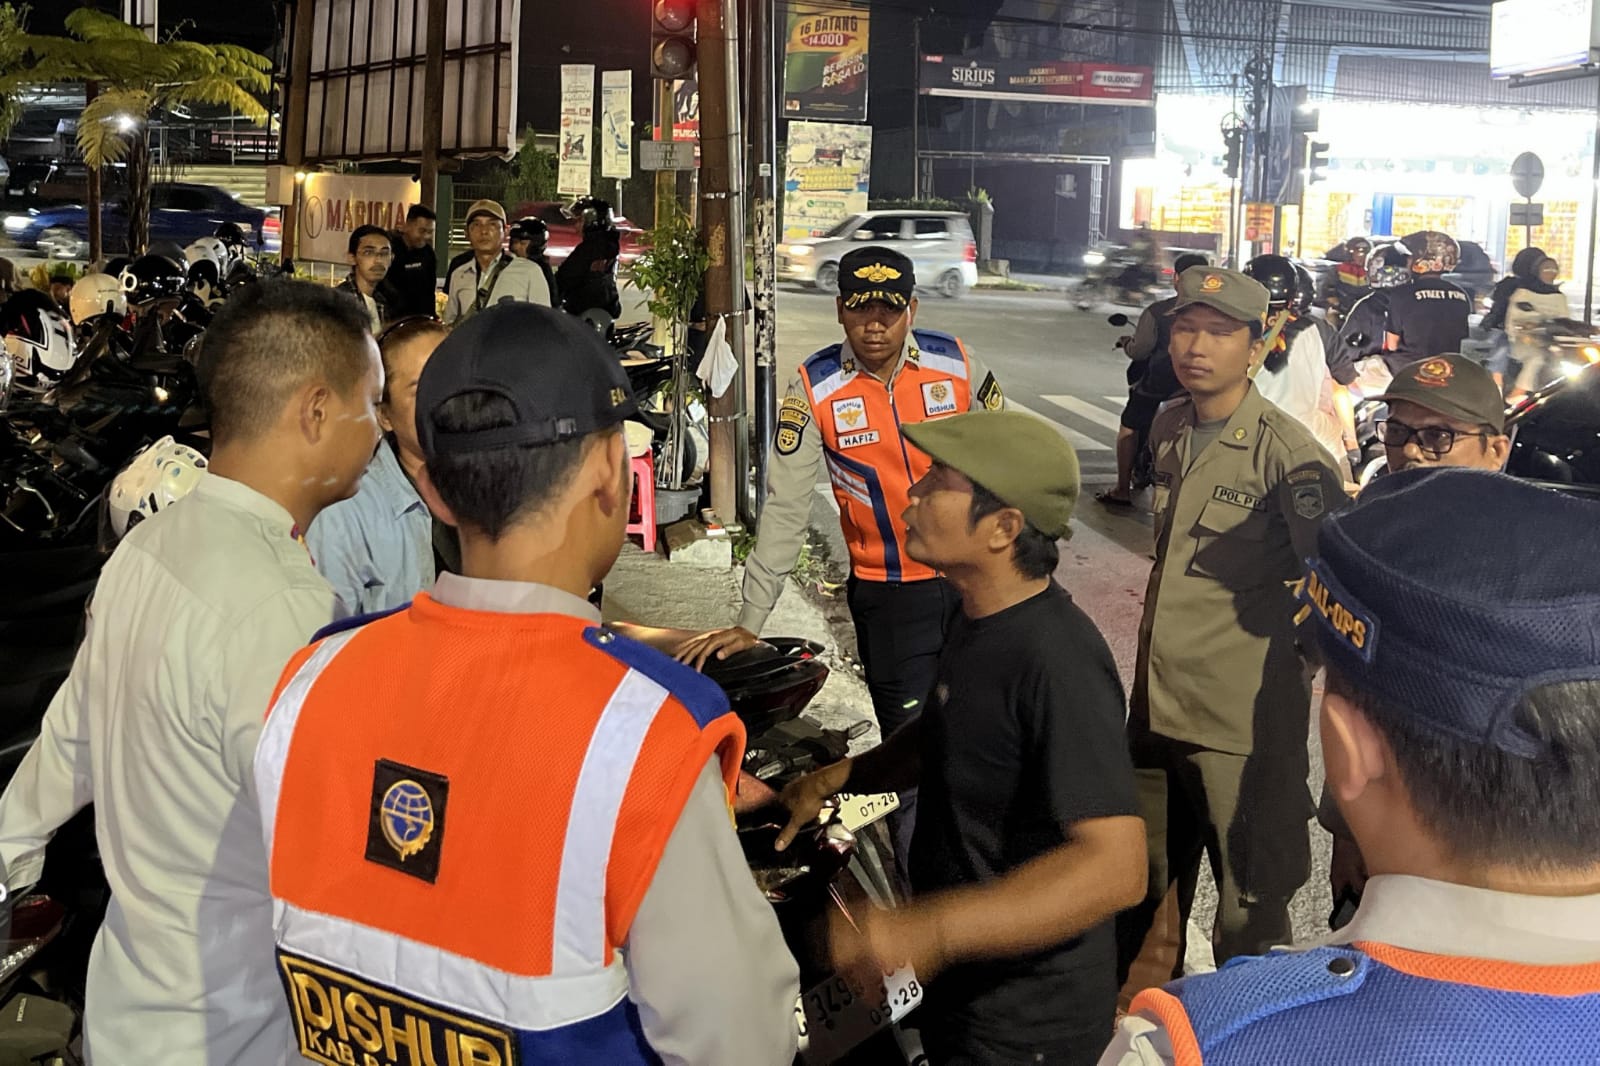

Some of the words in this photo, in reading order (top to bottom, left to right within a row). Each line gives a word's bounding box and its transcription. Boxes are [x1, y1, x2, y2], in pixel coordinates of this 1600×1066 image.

[801, 22, 811, 35] 16
[815, 16, 858, 32] BATANG
[952, 68, 995, 83] SIRIUS
[929, 403, 955, 413] DISHUB
[844, 433, 874, 446] HAFIZ
[1219, 489, 1242, 503] POL
